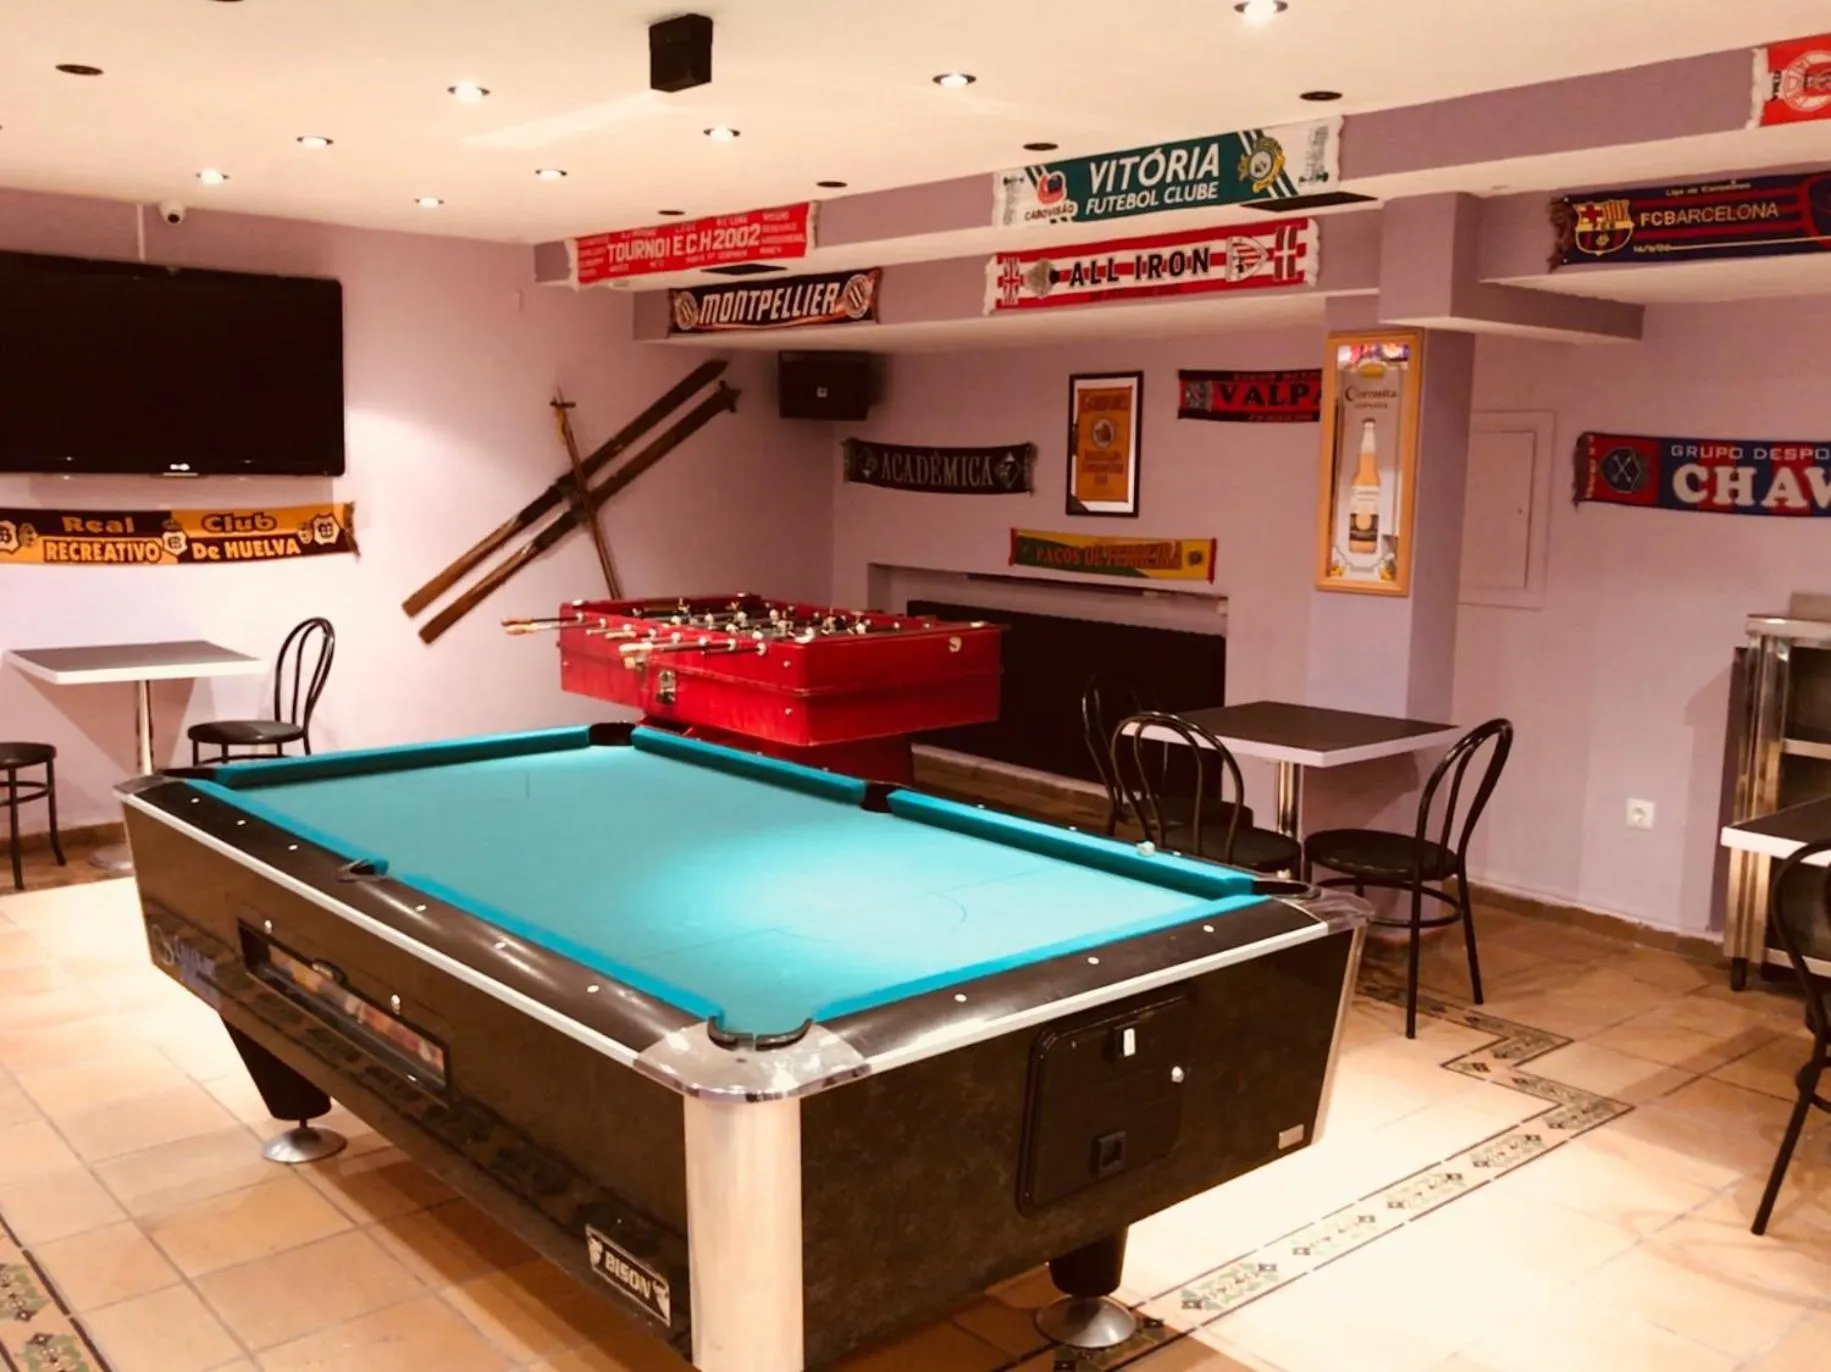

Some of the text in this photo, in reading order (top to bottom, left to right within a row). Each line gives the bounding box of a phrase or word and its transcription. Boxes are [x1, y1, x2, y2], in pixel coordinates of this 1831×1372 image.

[1088, 143, 1220, 194] VITÓRIA
[1085, 181, 1219, 215] FUTEBOL CLUBE
[1069, 247, 1211, 287] ALL IRON
[701, 282, 839, 324] MONTPELLIER
[1219, 383, 1322, 407] VALP
[1671, 444, 1744, 461] GRUPO
[61, 512, 279, 534] Real Club
[44, 538, 302, 562] RECREATIVO De HUELVA
[605, 1251, 651, 1300] BISON
